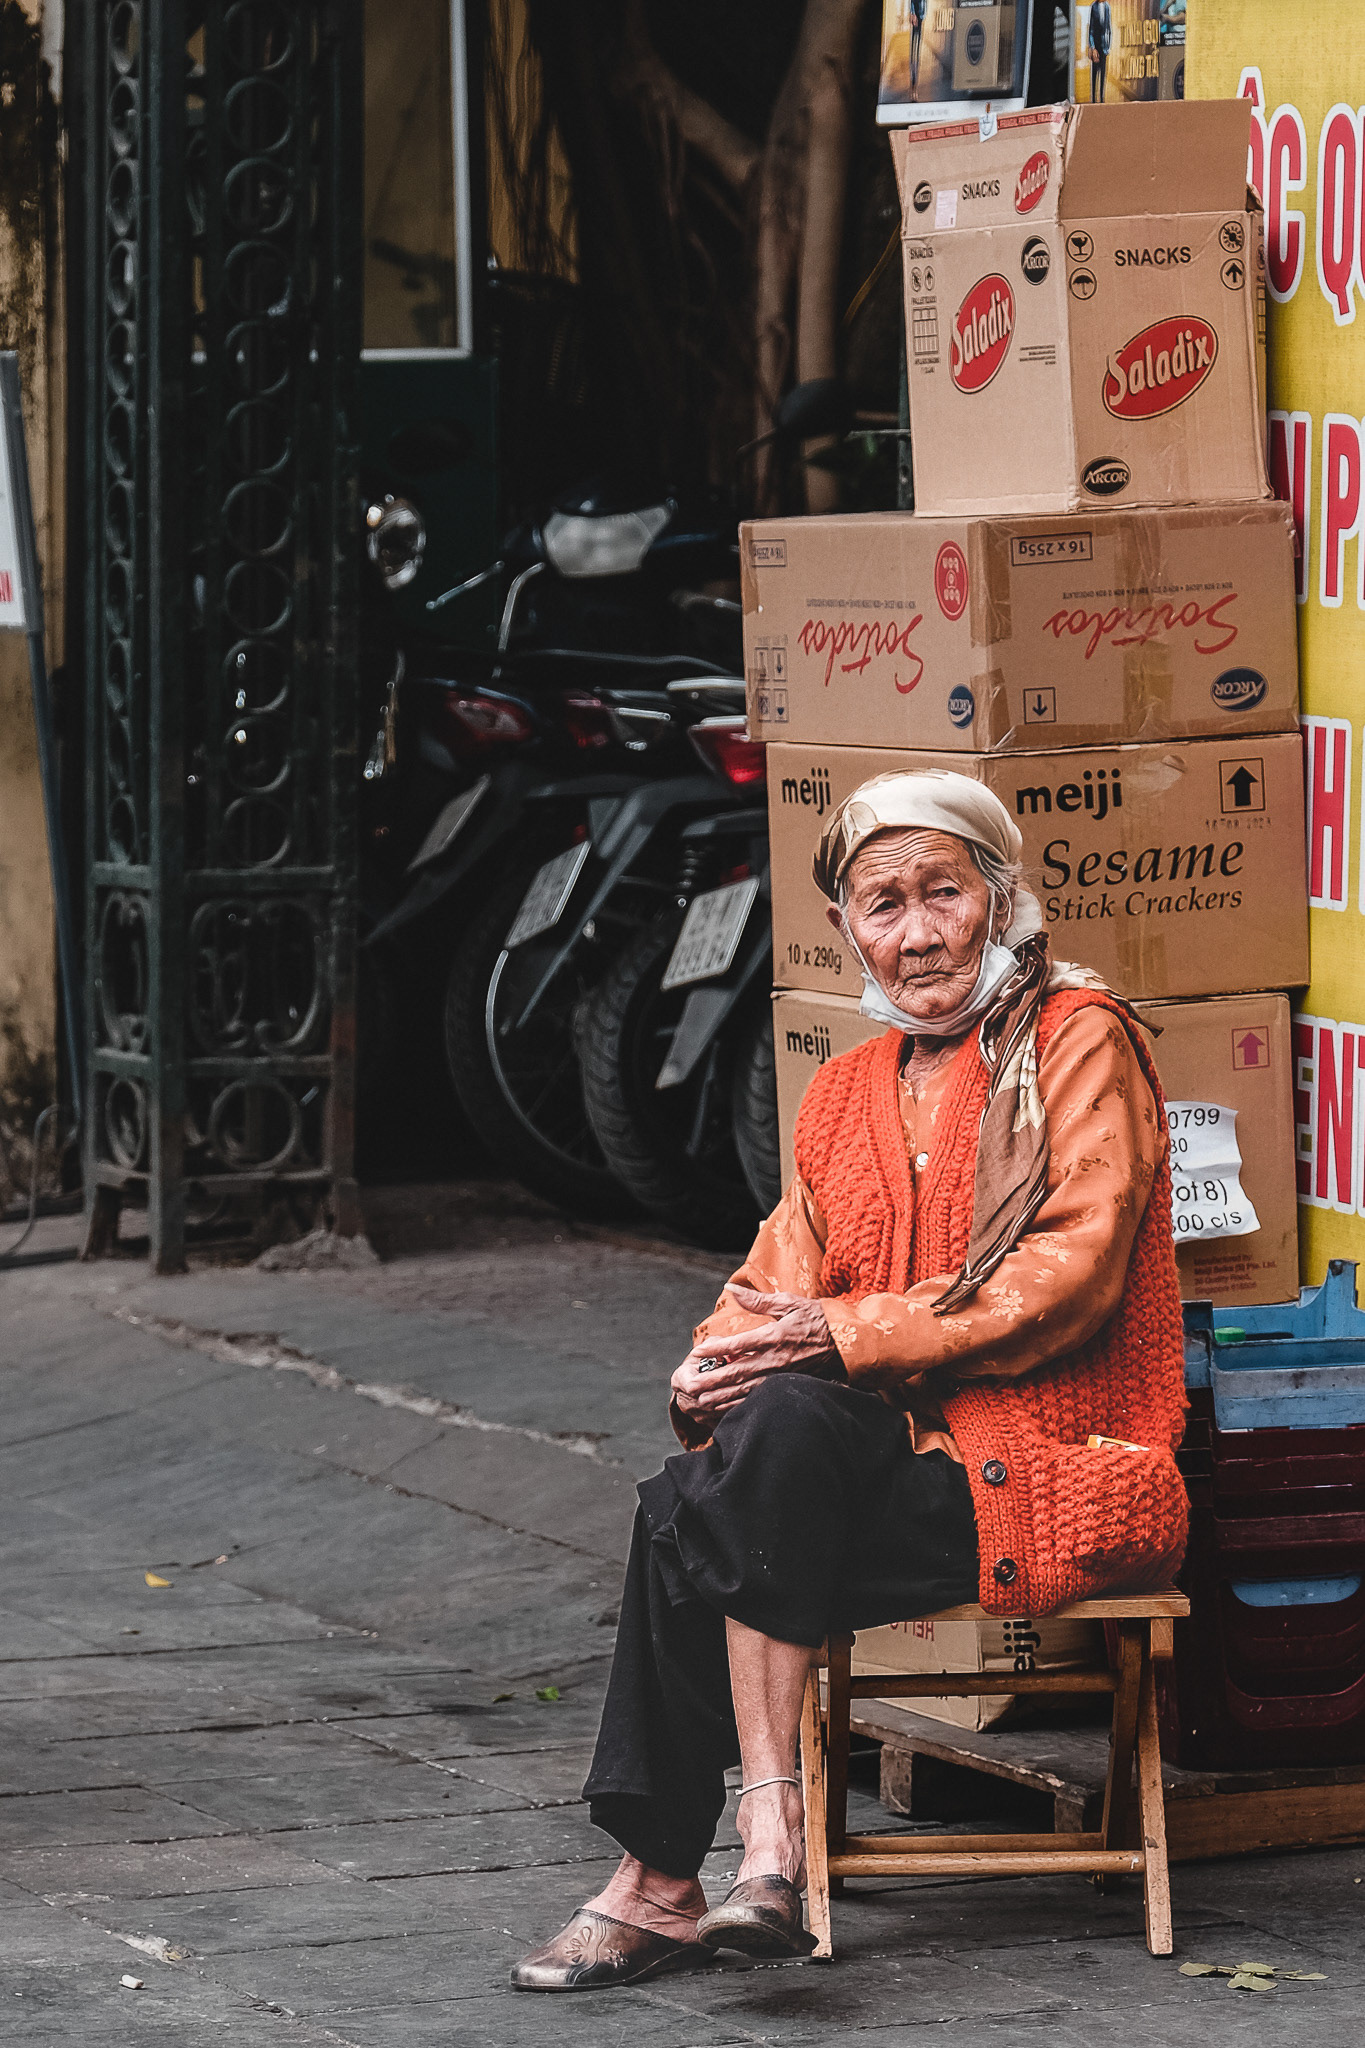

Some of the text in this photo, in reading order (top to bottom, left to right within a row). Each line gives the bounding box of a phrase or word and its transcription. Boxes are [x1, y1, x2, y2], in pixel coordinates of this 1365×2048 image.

[962, 180, 1000, 200] SNACKS
[1015, 159, 1049, 207] Saladix
[1320, 110, 1365, 317] Q
[1023, 253, 1050, 269] ARCOR
[1114, 246, 1192, 266] SNACKS
[952, 289, 1012, 377] Saladix
[1107, 329, 1211, 406] Saladix
[1083, 470, 1128, 485] ARCOR
[1325, 423, 1365, 599] P
[1018, 540, 1086, 556] 16 x 255g
[1042, 593, 1238, 660] Sortidos
[798, 614, 923, 694] Sortidos
[1214, 680, 1266, 698] ARCOR
[782, 767, 831, 816] meiji
[1016, 768, 1123, 820] meiji
[1301, 724, 1346, 902] H
[1042, 839, 1244, 890] Sesame
[1045, 886, 1243, 922] Stick Crackers
[787, 943, 842, 975] 10 x 290g
[785, 1025, 832, 1065] meiji
[1172, 1214, 1204, 1233] 00
[1002, 1618, 1042, 1673] eiji
